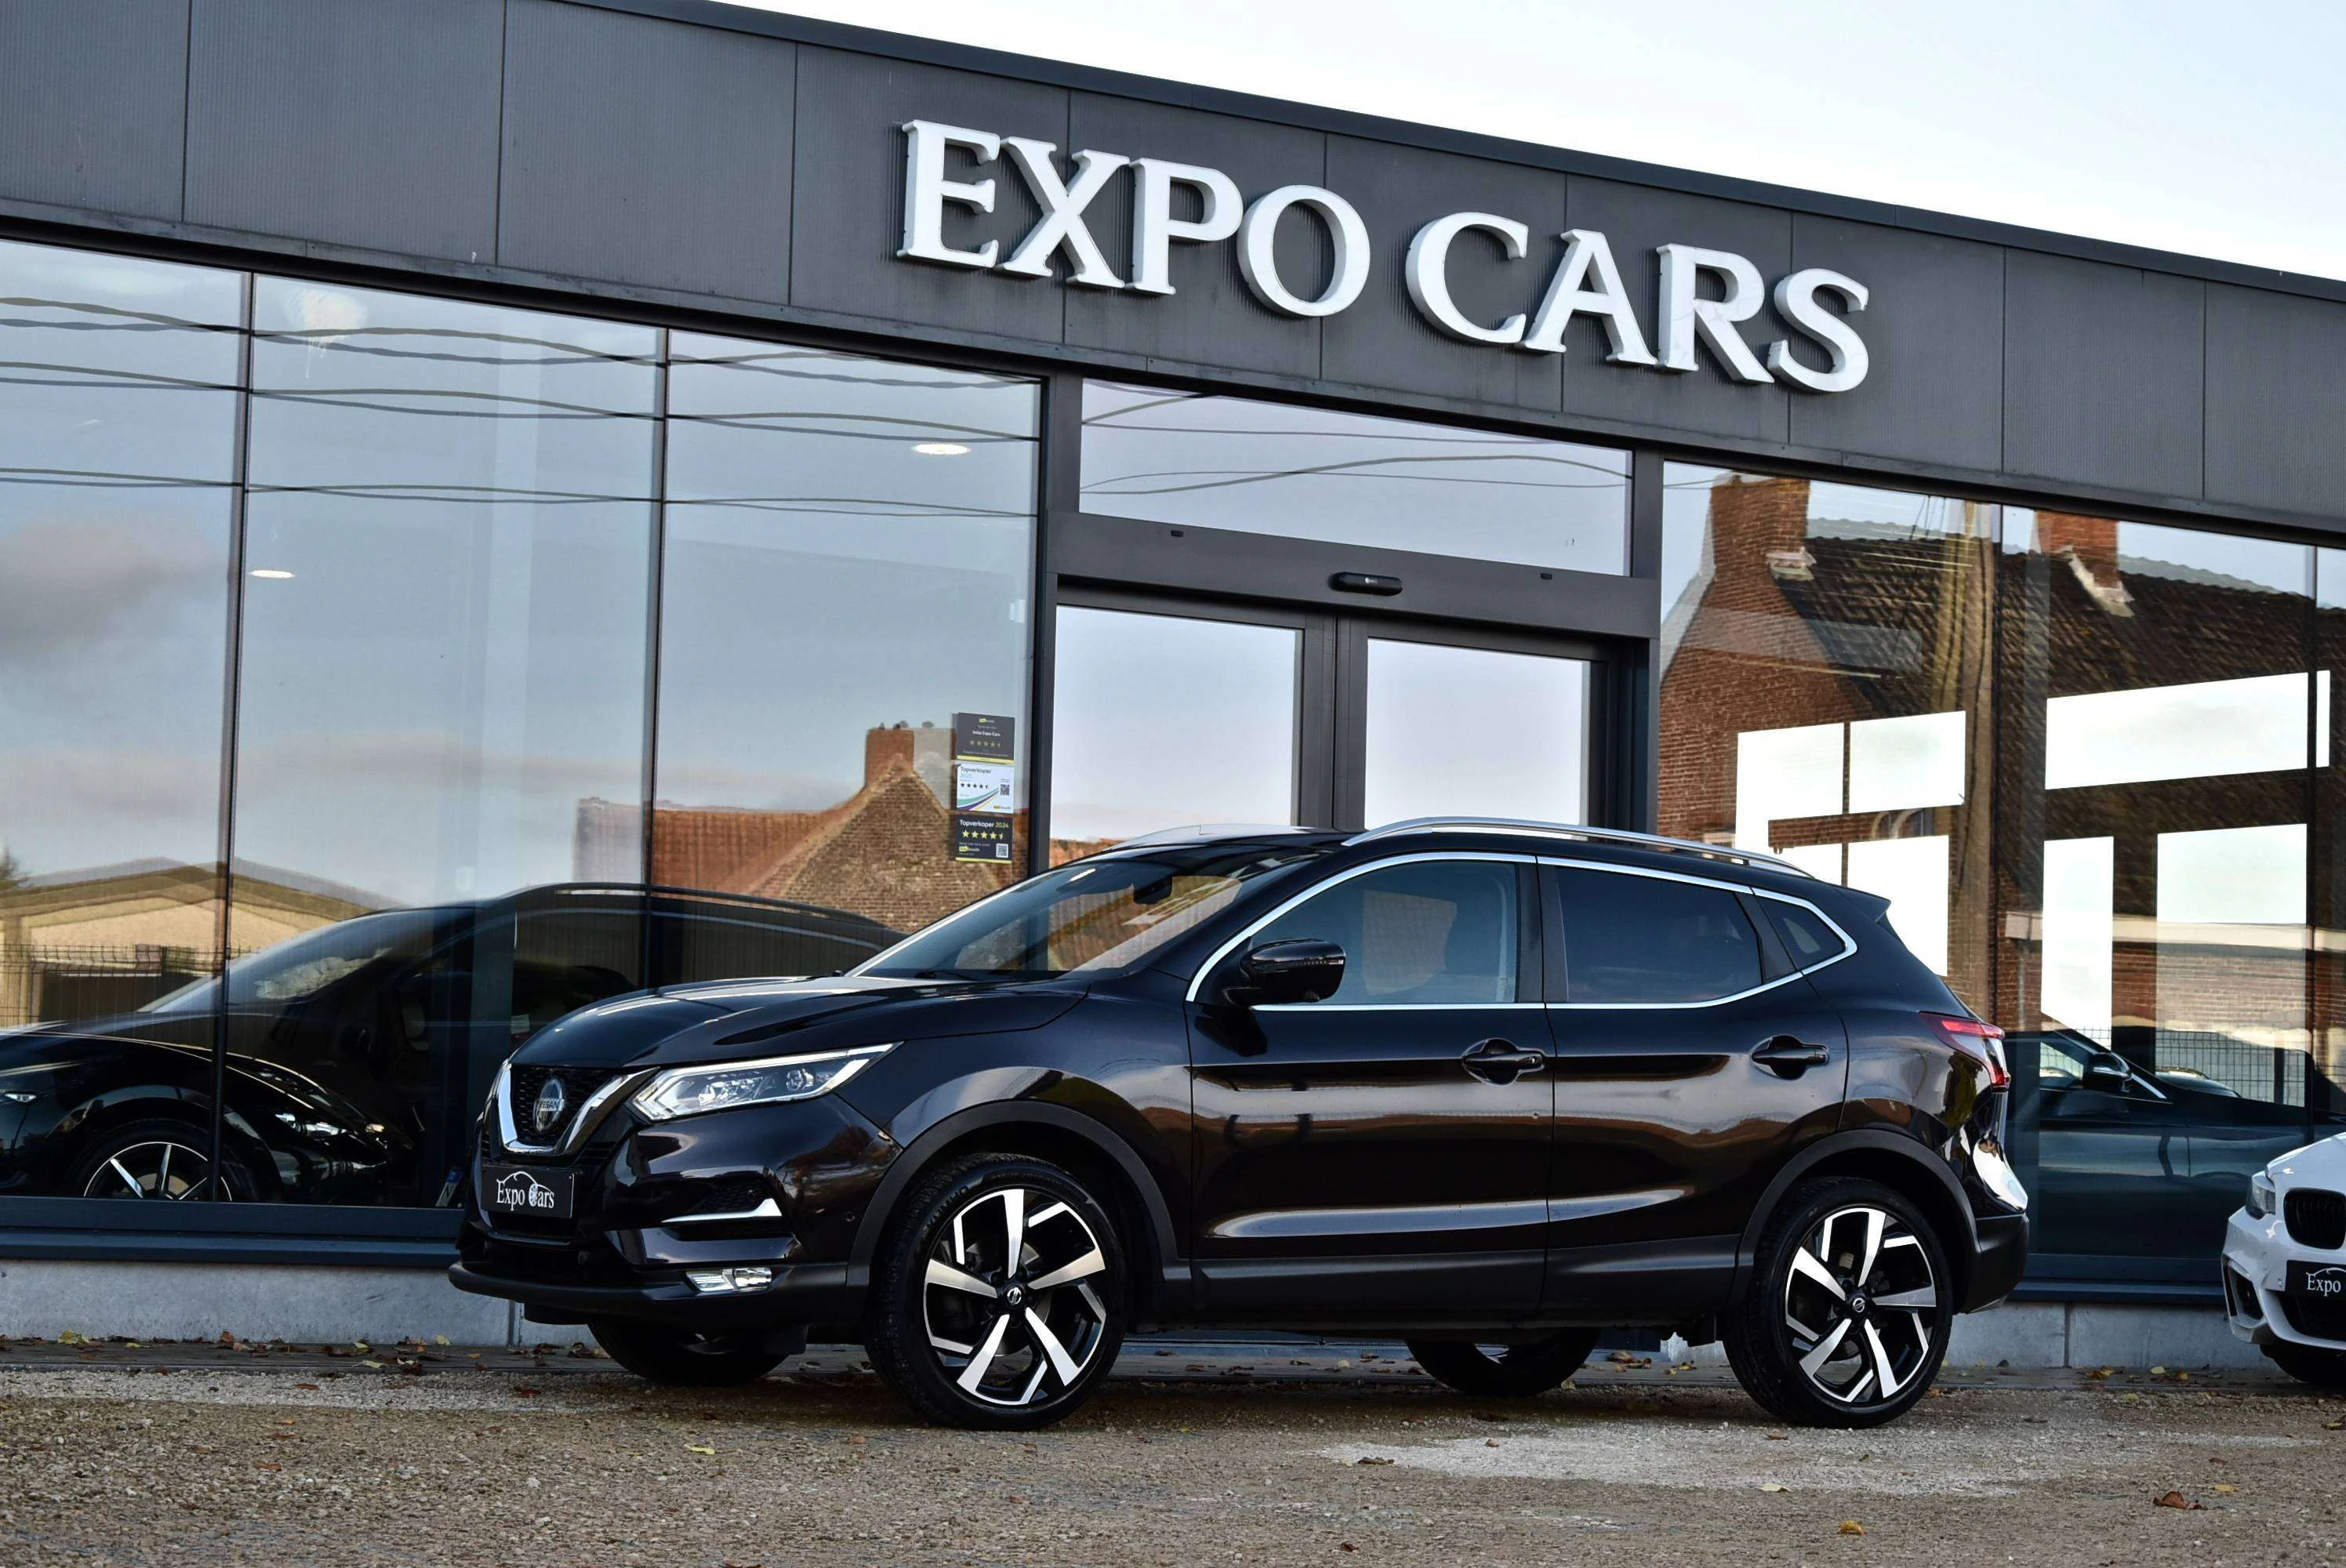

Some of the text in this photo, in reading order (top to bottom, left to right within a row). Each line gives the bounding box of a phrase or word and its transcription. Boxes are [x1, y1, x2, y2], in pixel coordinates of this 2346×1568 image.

[897, 120, 1870, 394] EXPO CARS
[960, 819, 995, 829] Topverkoper
[496, 1178, 555, 1211] Expo Cars
[2306, 1272, 2341, 1298] Expo
